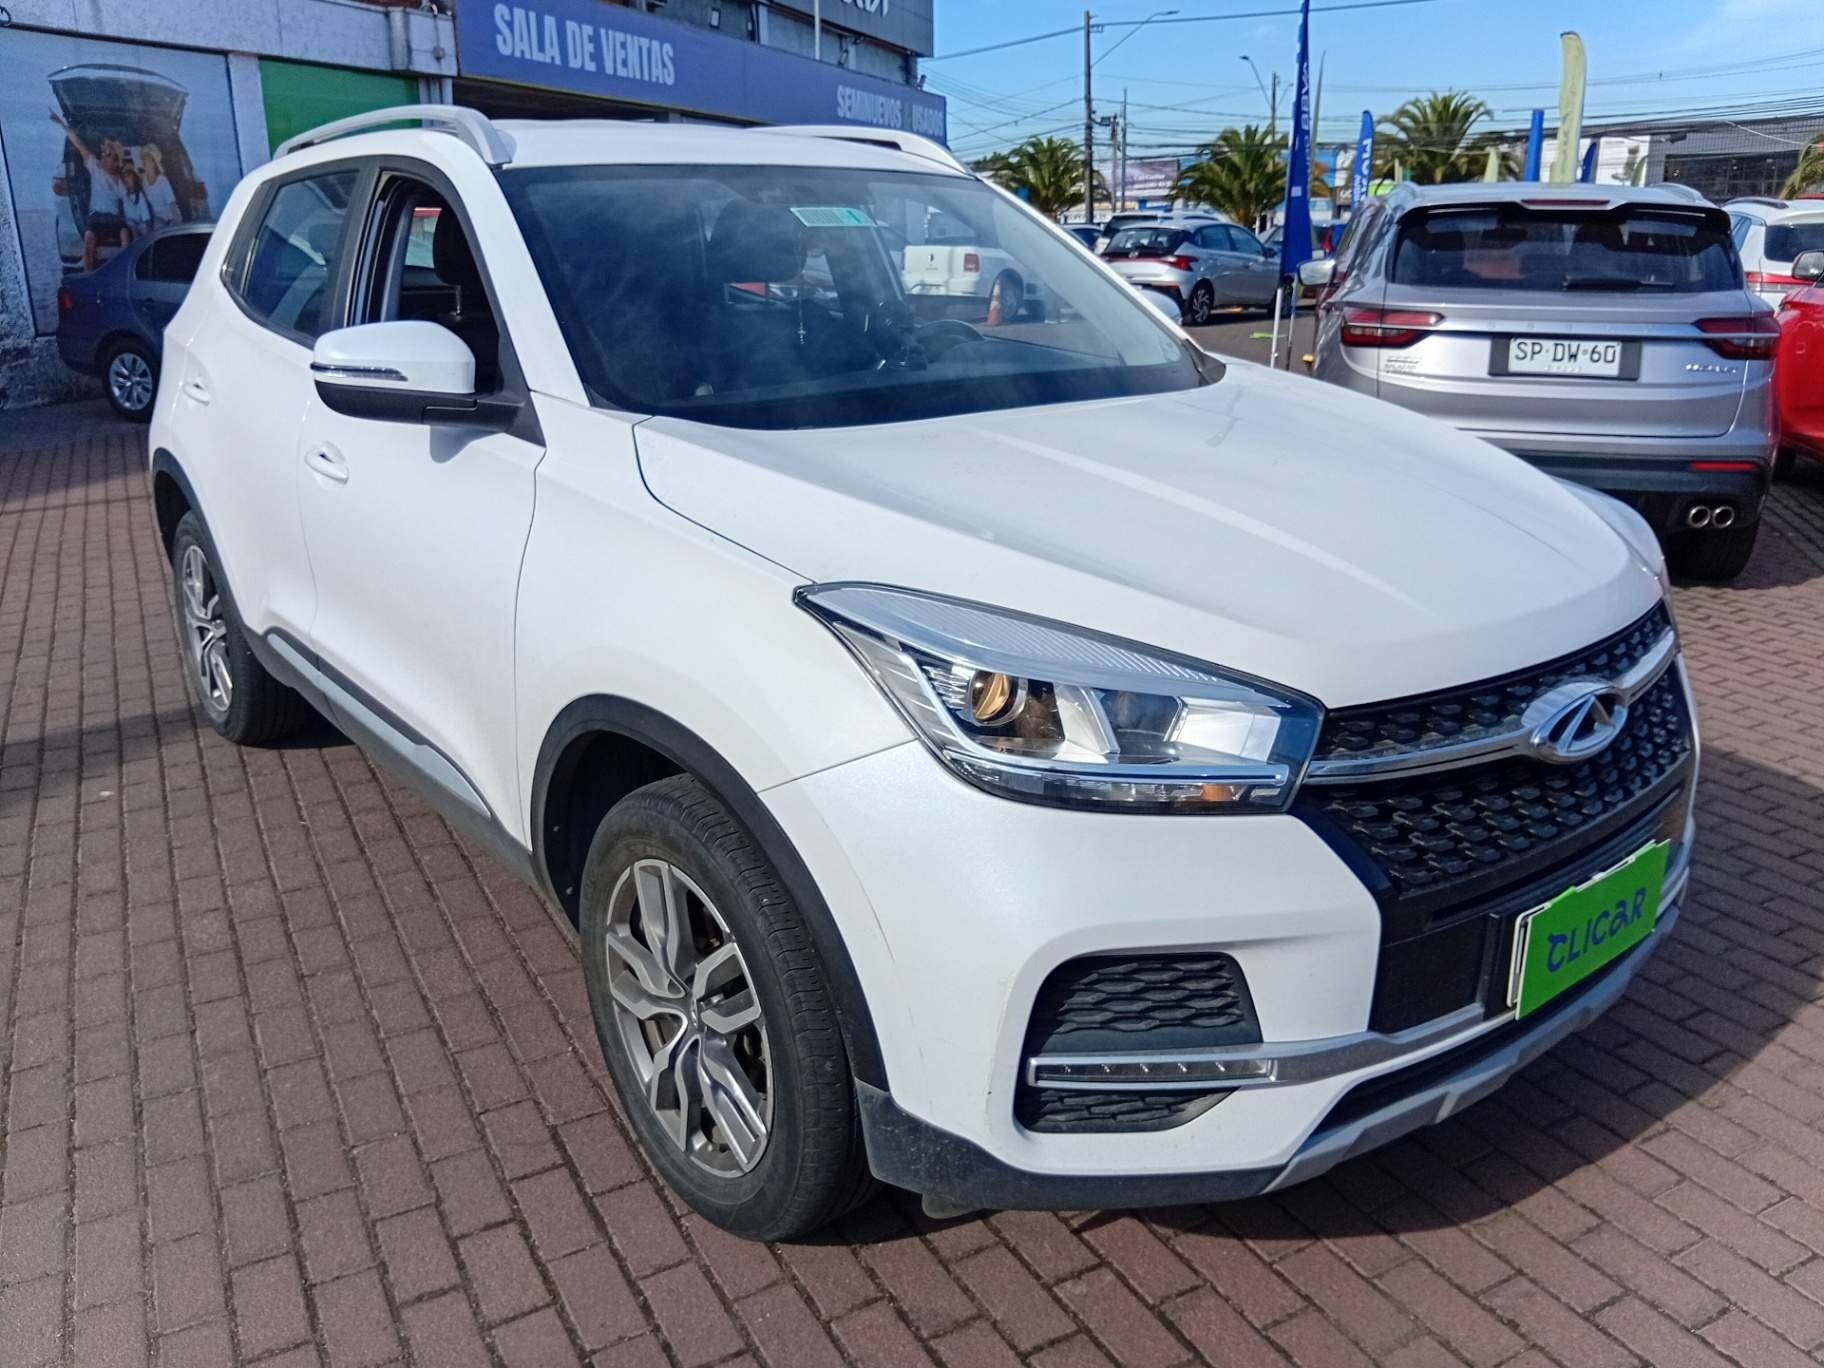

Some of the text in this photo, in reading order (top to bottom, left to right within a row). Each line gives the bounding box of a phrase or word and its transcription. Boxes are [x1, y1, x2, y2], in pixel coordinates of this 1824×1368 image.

[494, 3, 675, 86] SALA DE VENTAS
